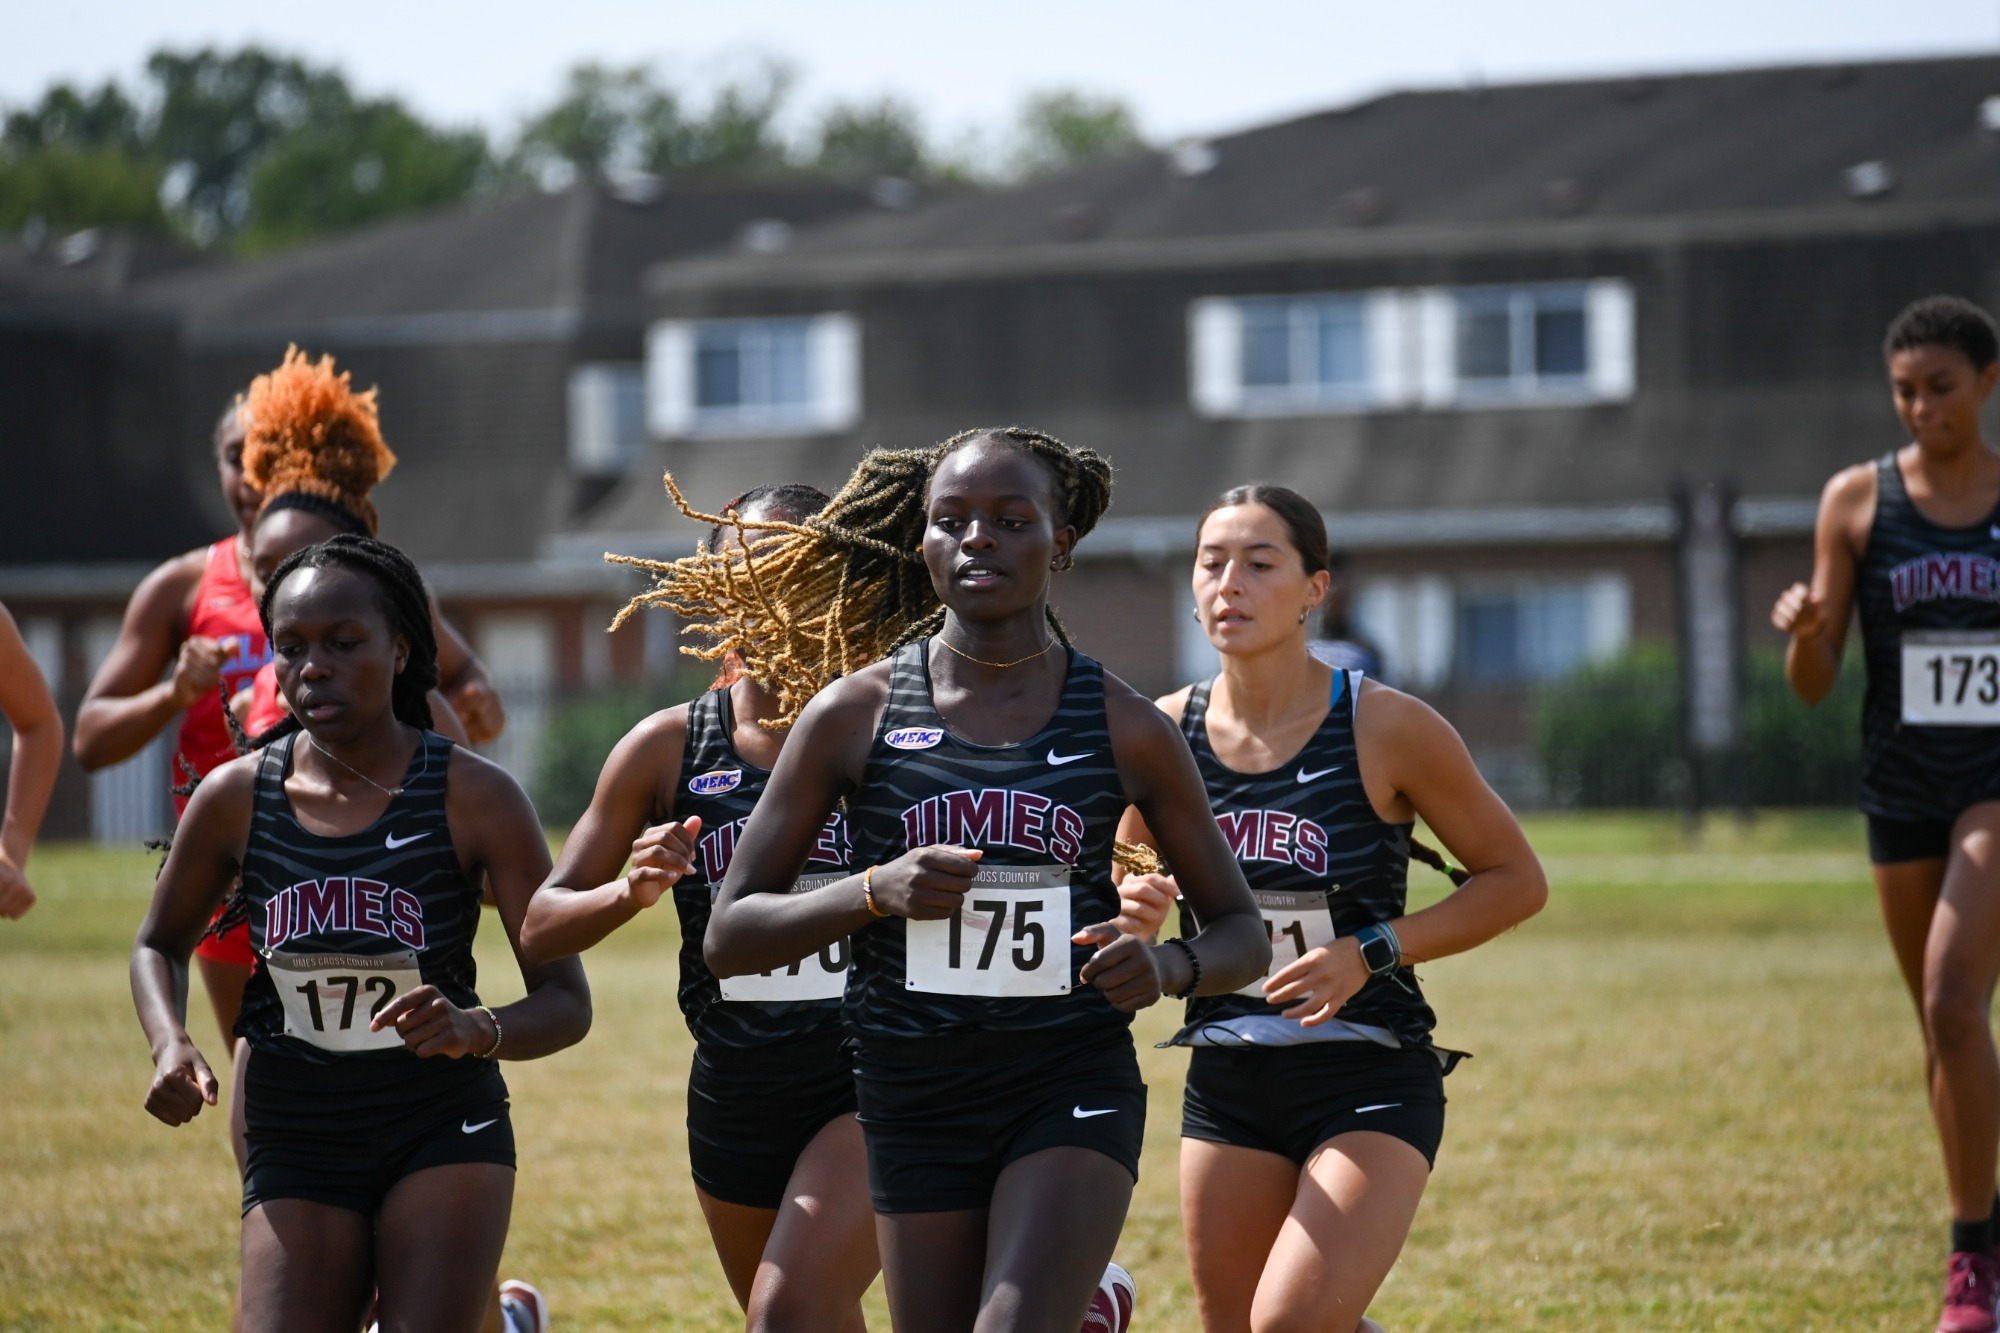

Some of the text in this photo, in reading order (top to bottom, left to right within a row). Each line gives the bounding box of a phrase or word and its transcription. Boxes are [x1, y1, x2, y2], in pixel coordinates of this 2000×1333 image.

[1889, 552, 2000, 613] UME
[1926, 655, 2000, 706] 173
[892, 731, 941, 744] MEAC
[695, 773, 739, 790] MEAC
[700, 812, 852, 884] UE
[901, 788, 1085, 864] UMES
[1000, 871, 1041, 883] COUNTRY
[1262, 894, 1296, 906] COUNTRY
[265, 876, 425, 950] UMES
[948, 900, 1045, 972] 175
[292, 957, 385, 967] UMES CROSS COUNTRY
[296, 975, 397, 1032] 172
